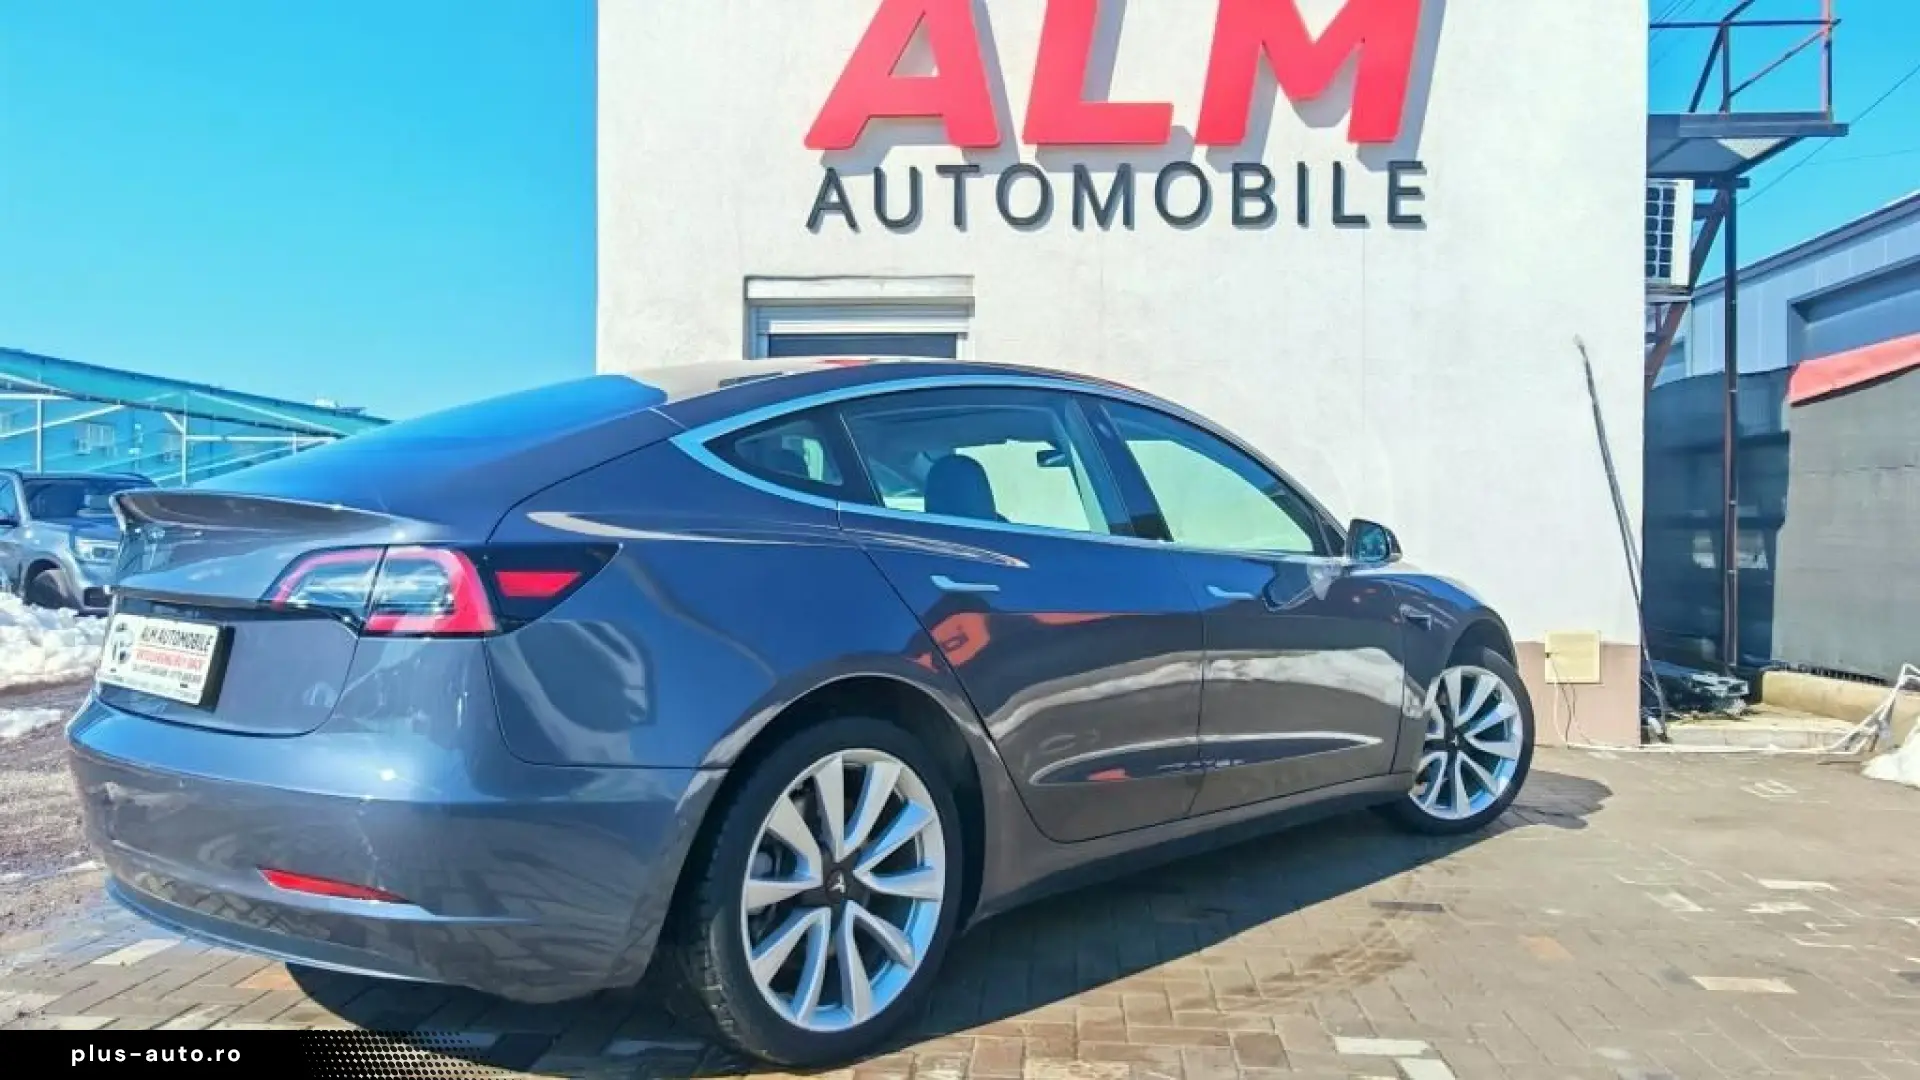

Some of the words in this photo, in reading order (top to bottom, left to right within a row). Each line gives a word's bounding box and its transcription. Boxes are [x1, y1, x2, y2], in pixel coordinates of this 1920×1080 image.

[804, 0, 1422, 150] ALM
[806, 161, 1425, 230] AUTOMOBILE
[158, 628, 214, 652] AUTOMOBILE
